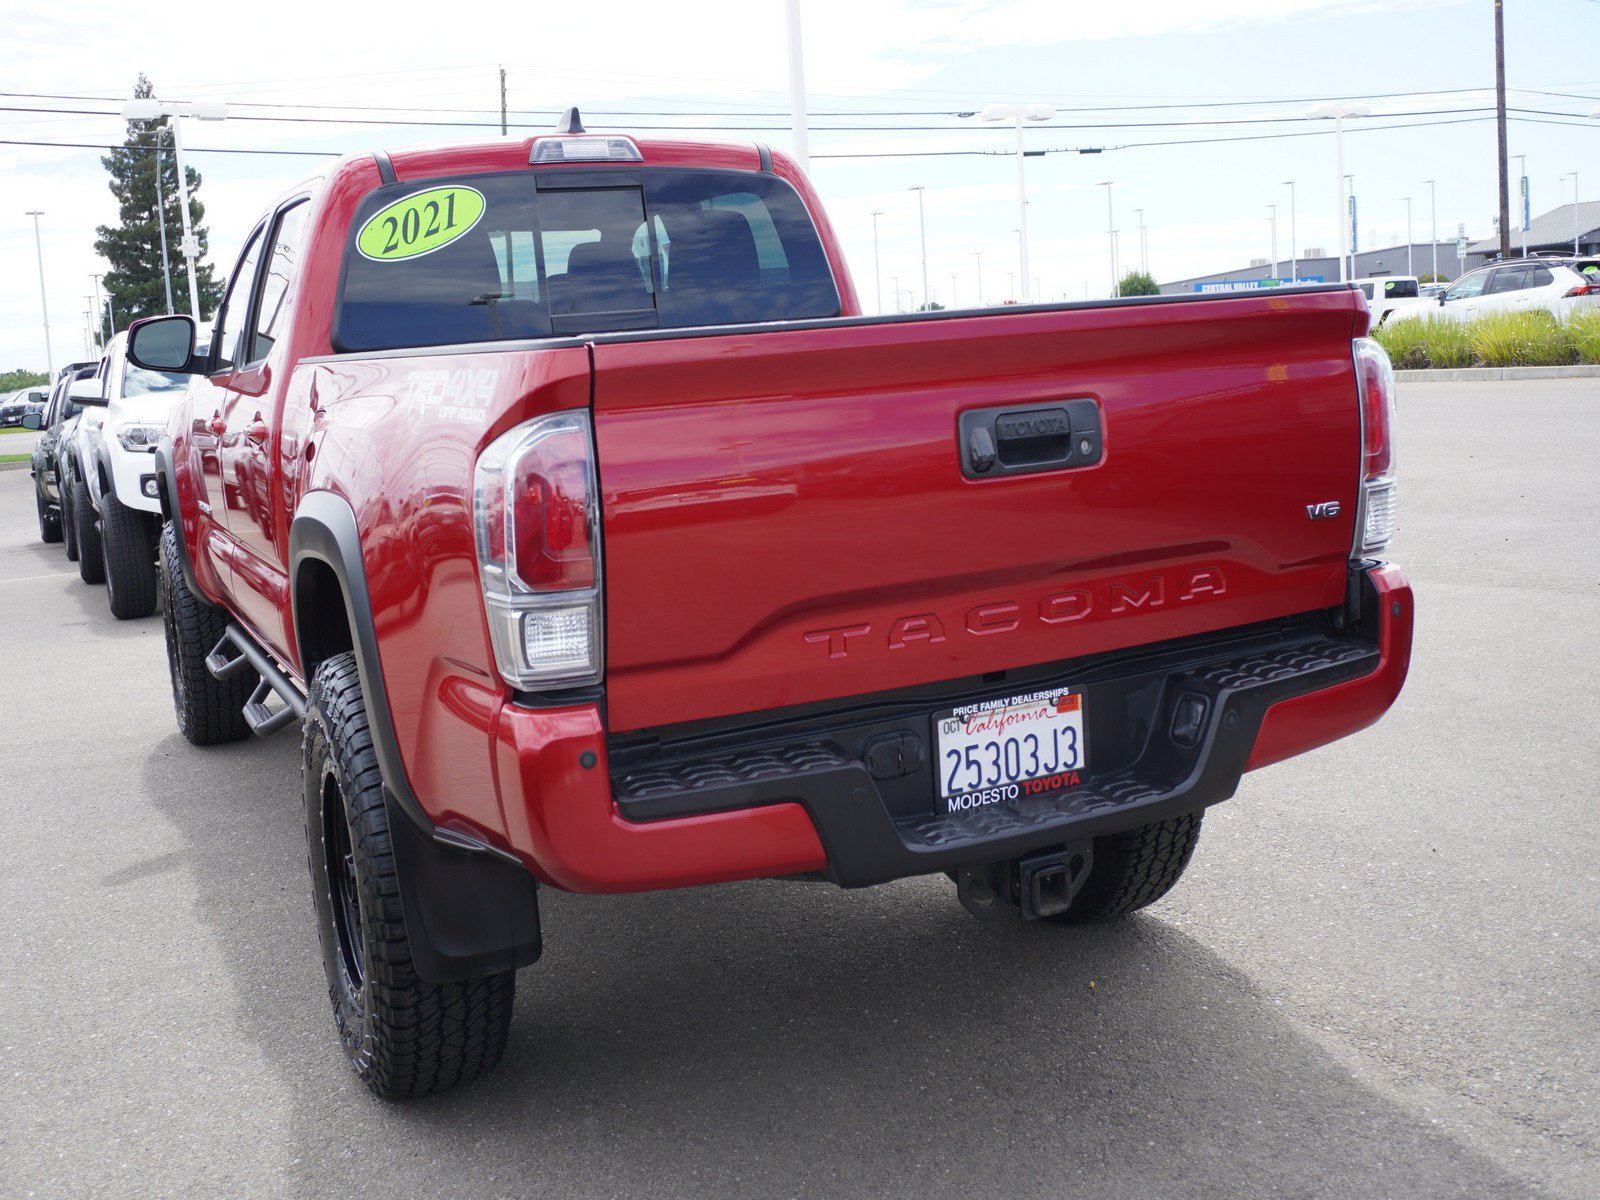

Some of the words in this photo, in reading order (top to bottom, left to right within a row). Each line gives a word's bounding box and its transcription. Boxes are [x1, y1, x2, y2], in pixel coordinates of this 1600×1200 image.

[381, 192, 457, 255] 2021
[1234, 281, 1259, 290] VALLEY
[1005, 416, 1067, 437] TOYOTA
[1306, 501, 1340, 519] V6
[803, 565, 1227, 659] TACOMA
[953, 705, 979, 717] PRICE
[979, 698, 1010, 712] FAMILY
[1011, 687, 1069, 705] DEALERSHIPS
[943, 720, 961, 735] OCT
[965, 707, 1057, 736] California
[947, 725, 1078, 794] 25303J3
[948, 784, 1020, 812] MODESTO
[1023, 771, 1081, 795] TOYOTA
